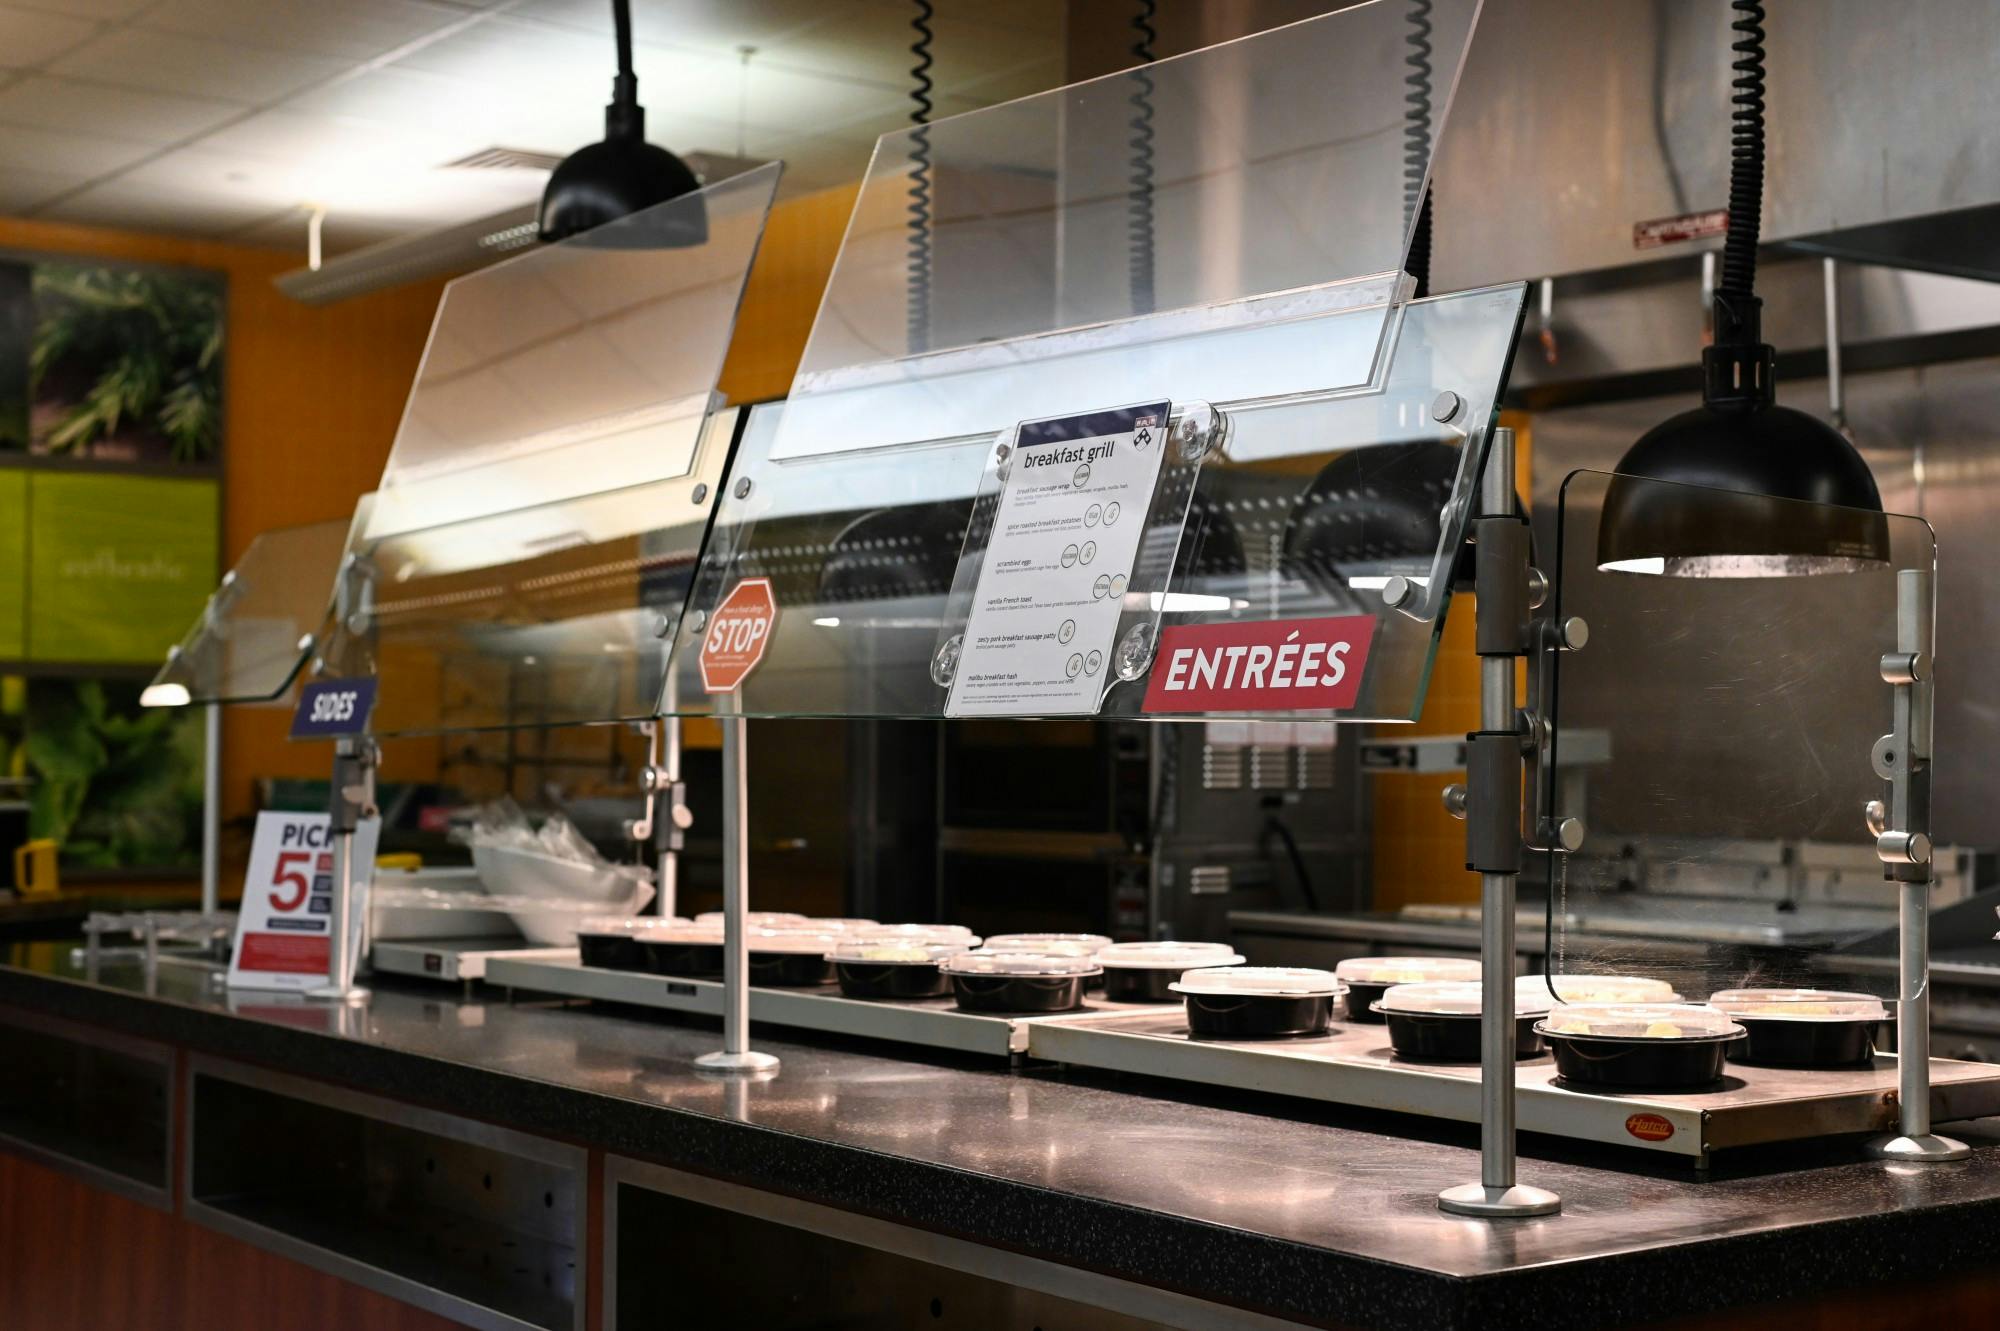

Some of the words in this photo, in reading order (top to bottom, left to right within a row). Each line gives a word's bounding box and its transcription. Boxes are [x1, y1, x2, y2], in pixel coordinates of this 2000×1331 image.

[1024, 447, 1084, 468] breakfast
[1088, 441, 1115, 464] grill
[1038, 519, 1060, 527] breakfast
[1060, 517, 1082, 526] potatoes
[708, 618, 766, 653] STOP
[1002, 634, 1024, 642] breakfast
[1043, 632, 1056, 640] patty
[1163, 630, 1351, 691] ENTRÉES
[310, 692, 357, 722] SIDES
[268, 851, 311, 913] 5
